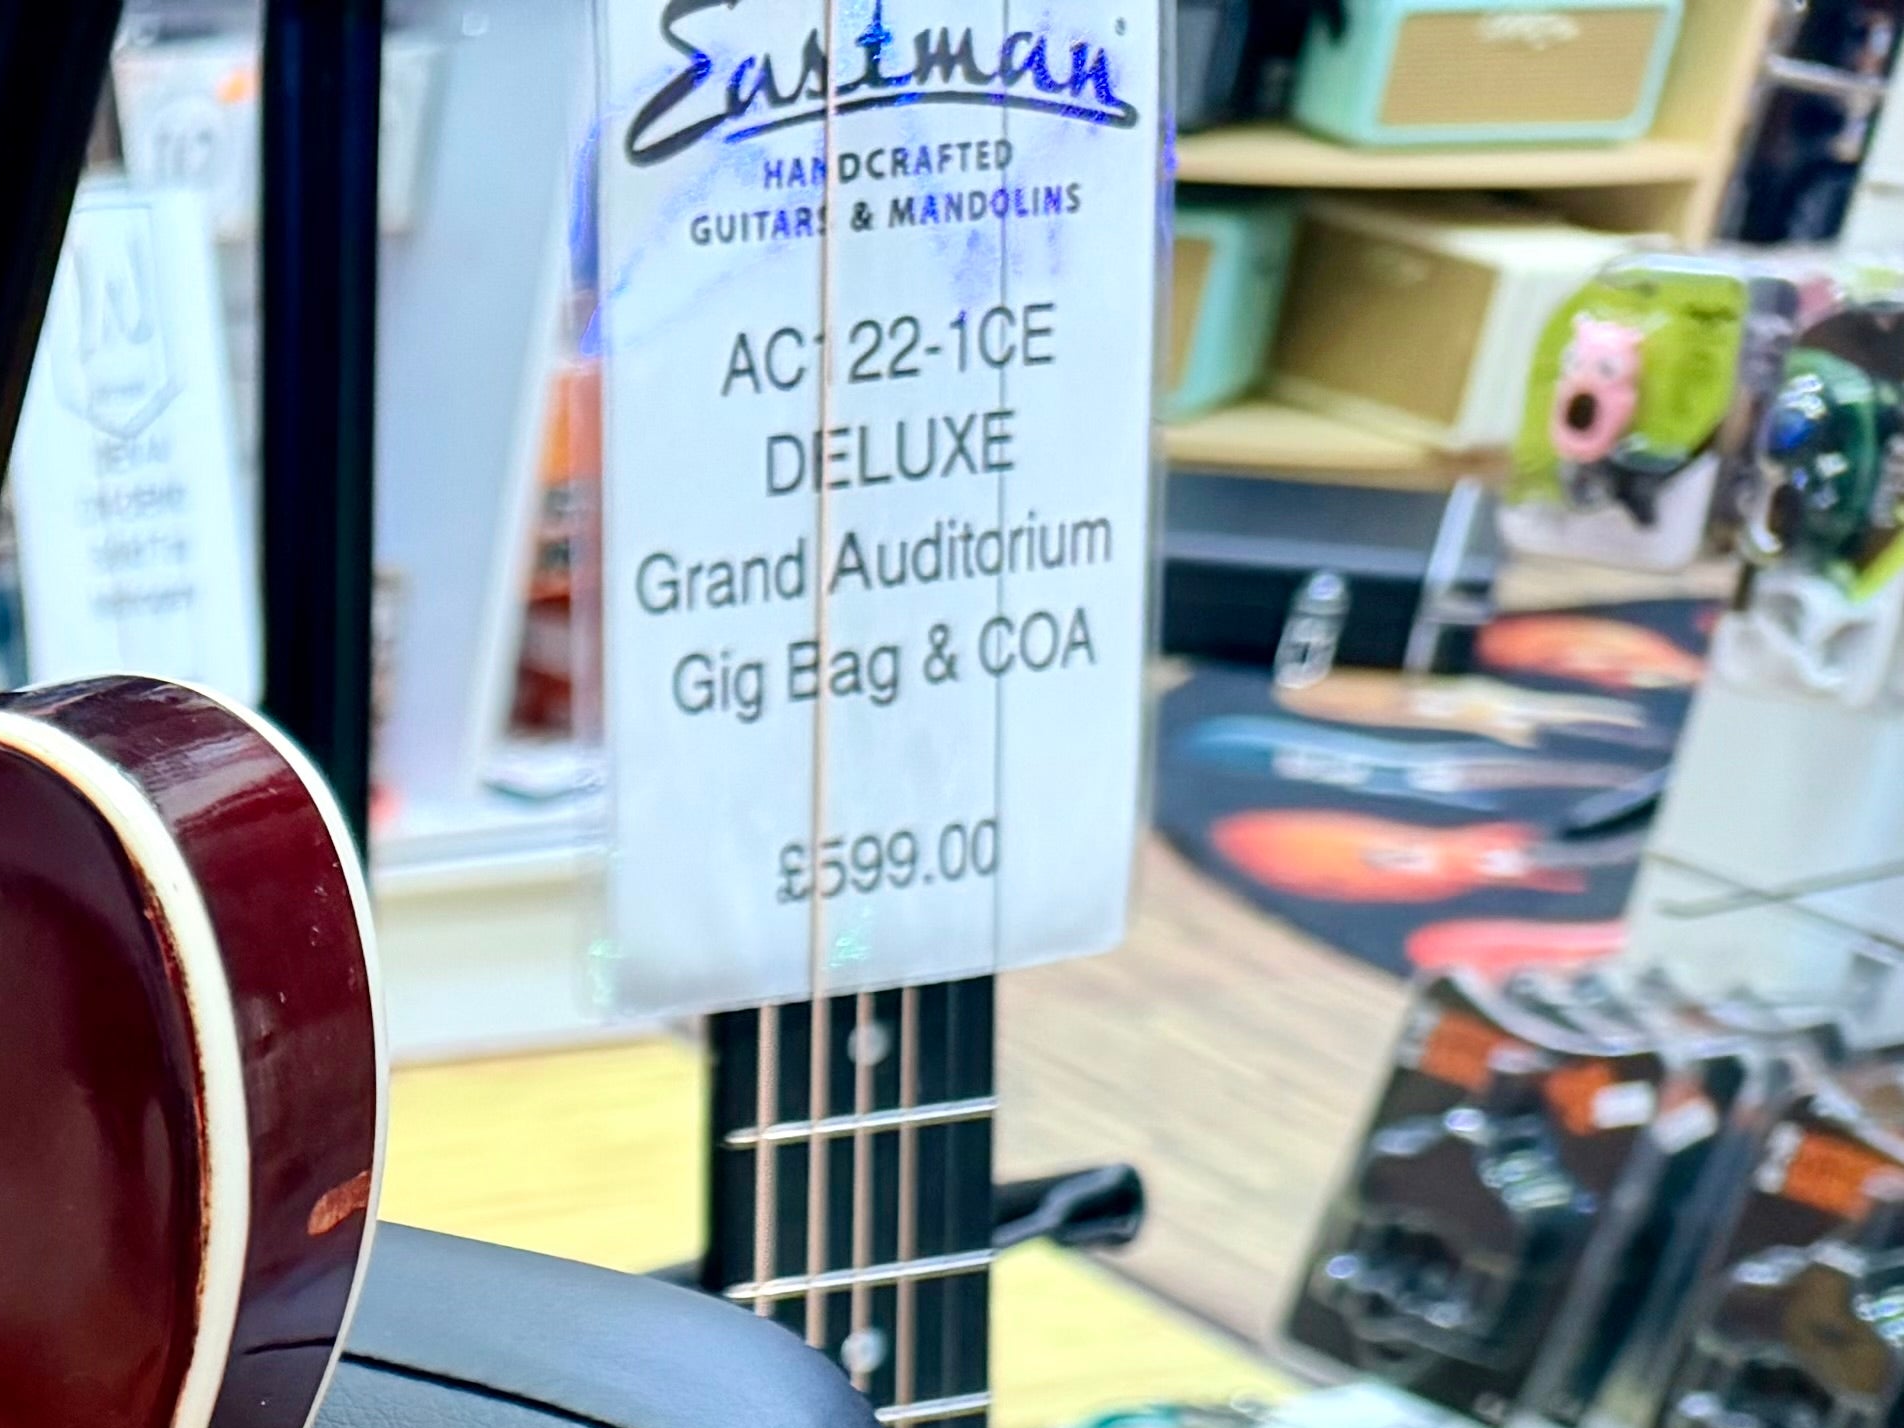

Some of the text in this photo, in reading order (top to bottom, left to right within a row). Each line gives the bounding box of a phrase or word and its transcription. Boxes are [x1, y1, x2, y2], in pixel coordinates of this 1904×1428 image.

[626, 0, 1139, 167] Eastman
[763, 139, 1014, 190] HANDCRAFTED
[690, 181, 1083, 247] GUITARS & MANDOLINS
[765, 409, 1017, 498] DELUXE
[635, 509, 1112, 615] Grand Auditorium
[672, 606, 1096, 724] Gig Bag & COA
[776, 818, 1000, 905] £599.00
